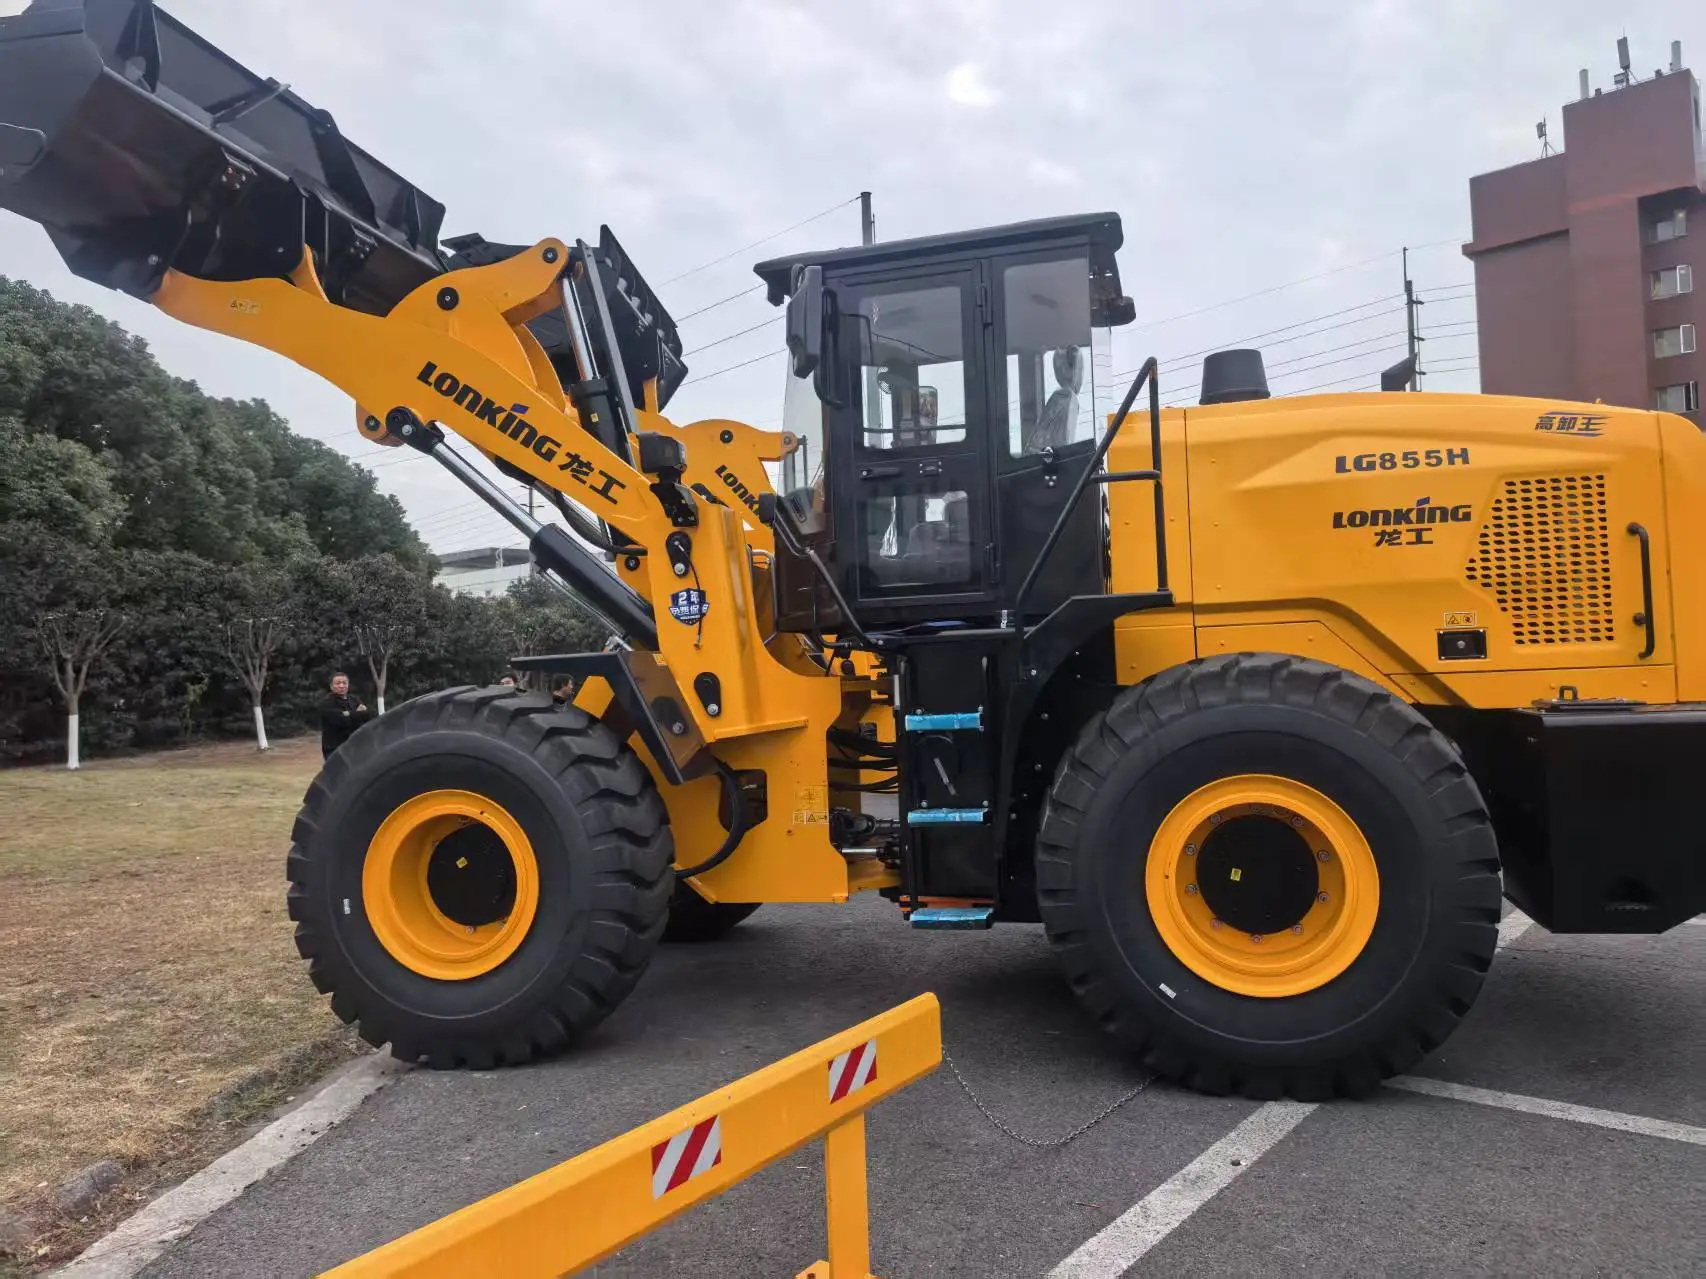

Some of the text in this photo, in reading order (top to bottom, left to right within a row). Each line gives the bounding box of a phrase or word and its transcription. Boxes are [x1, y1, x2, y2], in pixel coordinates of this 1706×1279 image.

[1534, 416, 1611, 432] 高卸王
[1336, 448, 1469, 473] LG855H
[558, 451, 626, 505] 龙工
[1374, 527, 1434, 547] 龙工
